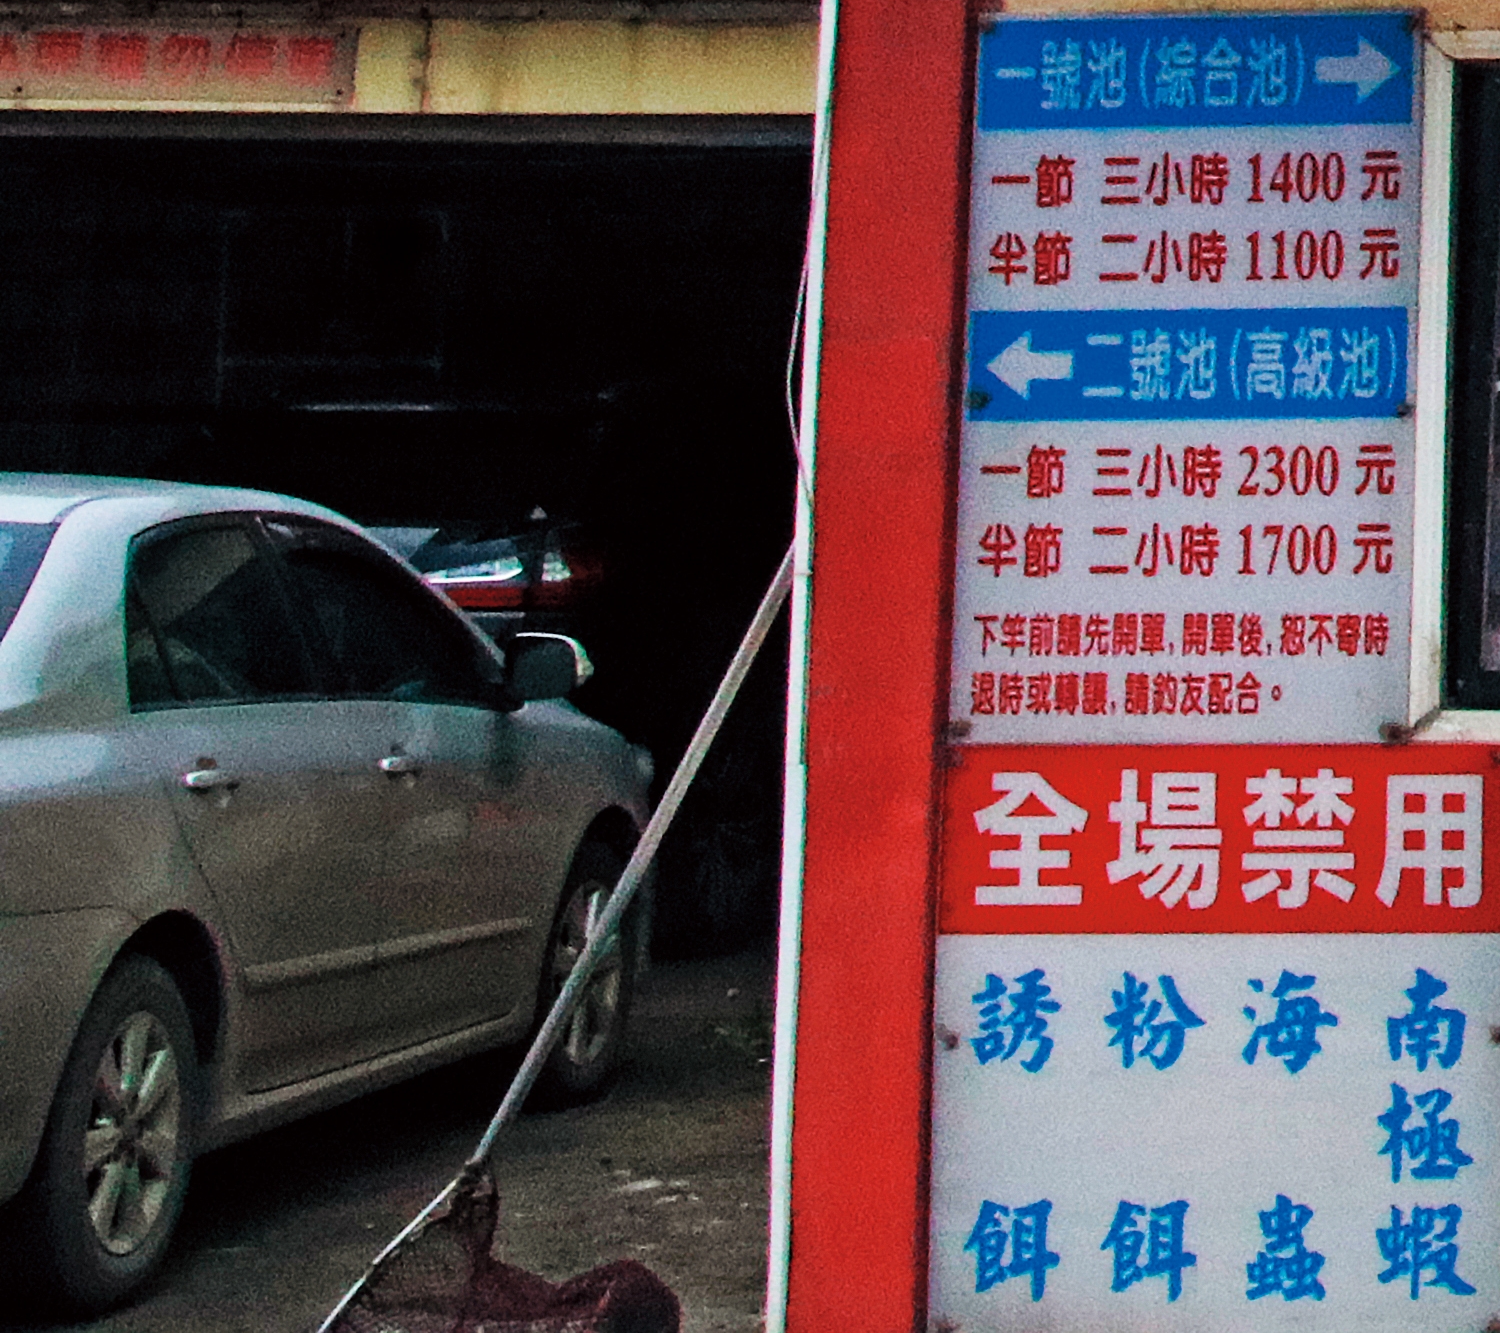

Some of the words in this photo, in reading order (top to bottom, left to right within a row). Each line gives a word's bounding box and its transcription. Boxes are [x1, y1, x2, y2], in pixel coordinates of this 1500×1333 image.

[994, 34, 1304, 110] 一號池(綜合池)
[991, 153, 1076, 208] 一節
[1100, 152, 1229, 206] 三小時
[1246, 150, 1346, 203] 1400
[1360, 150, 1402, 201] 元
[987, 229, 1074, 286] 半節
[1098, 229, 1229, 284] 二小時
[1245, 228, 1345, 282] 1100
[1359, 228, 1401, 280] 元
[1082, 326, 1398, 401] 二號池(高級池)
[979, 444, 1067, 499] 一節
[1092, 443, 1223, 498] 三小時
[1236, 445, 1340, 497] 2300
[1354, 444, 1397, 496] 元
[976, 523, 1064, 578] 半節
[1088, 522, 1220, 577] 二小時
[1236, 523, 1338, 576] 1700
[1352, 523, 1395, 575] 元
[973, 767, 1486, 909] 全場禁用
[964, 968, 1062, 1302] 誘餌
[1100, 971, 1207, 1302] 粉餌
[1241, 968, 1338, 1302] 海蟲
[1376, 968, 1478, 1301] 南極蝦
